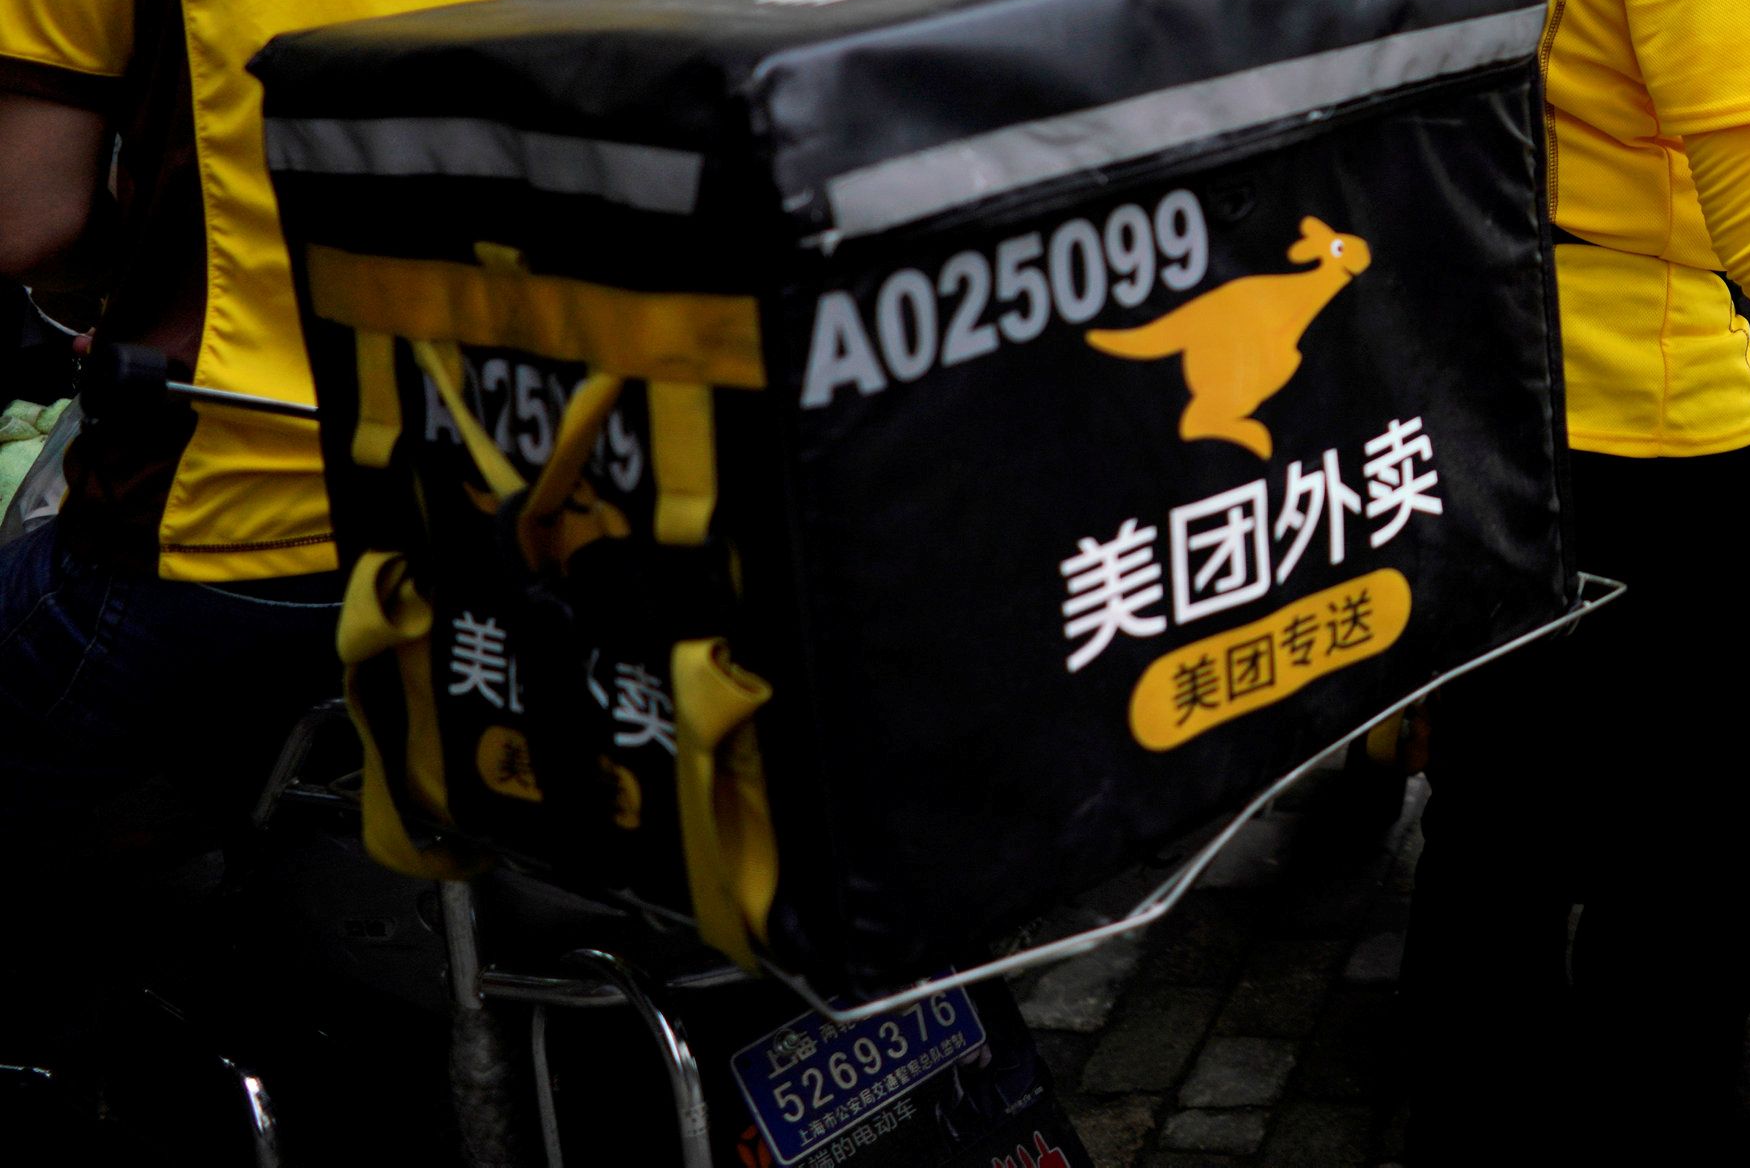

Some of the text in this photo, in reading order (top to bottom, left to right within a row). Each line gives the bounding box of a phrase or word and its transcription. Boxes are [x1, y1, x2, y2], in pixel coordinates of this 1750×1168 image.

[799, 188, 1210, 411] A025099
[1059, 415, 1444, 674] 美团外卖
[1172, 587, 1375, 727] 美团专送
[772, 991, 958, 1123] 5269376
